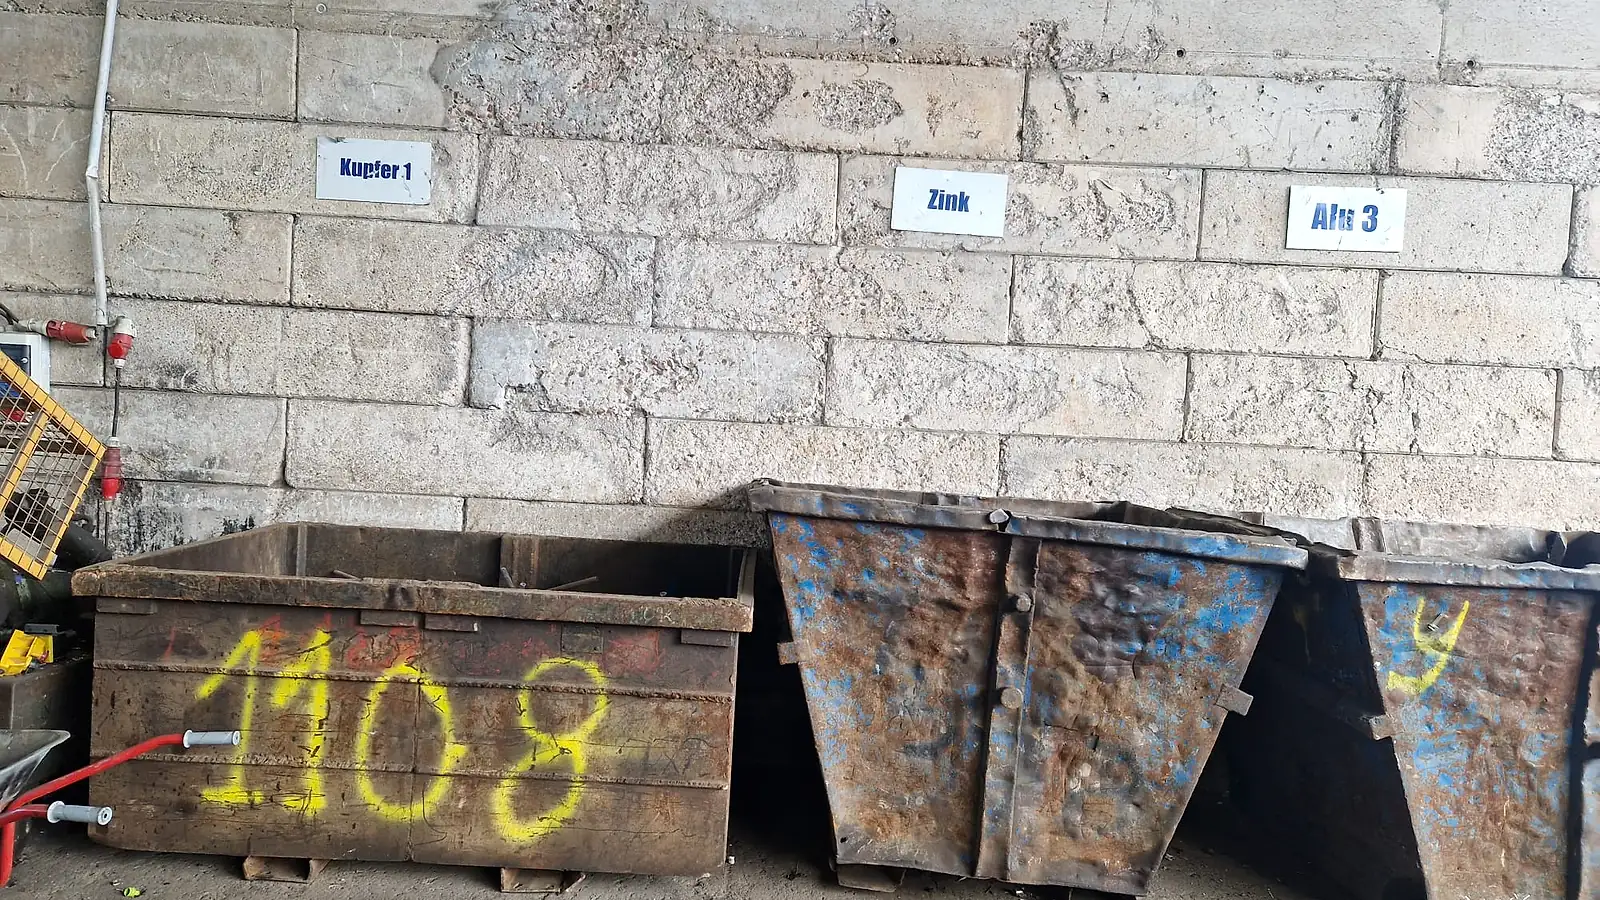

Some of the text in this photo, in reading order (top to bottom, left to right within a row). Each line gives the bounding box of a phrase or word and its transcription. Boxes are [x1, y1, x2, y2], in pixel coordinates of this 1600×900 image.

[340, 157, 411, 180] Kupfer 1
[927, 188, 970, 212] Zink
[1311, 202, 1379, 232] Alu 3
[195, 625, 612, 845] 1108
